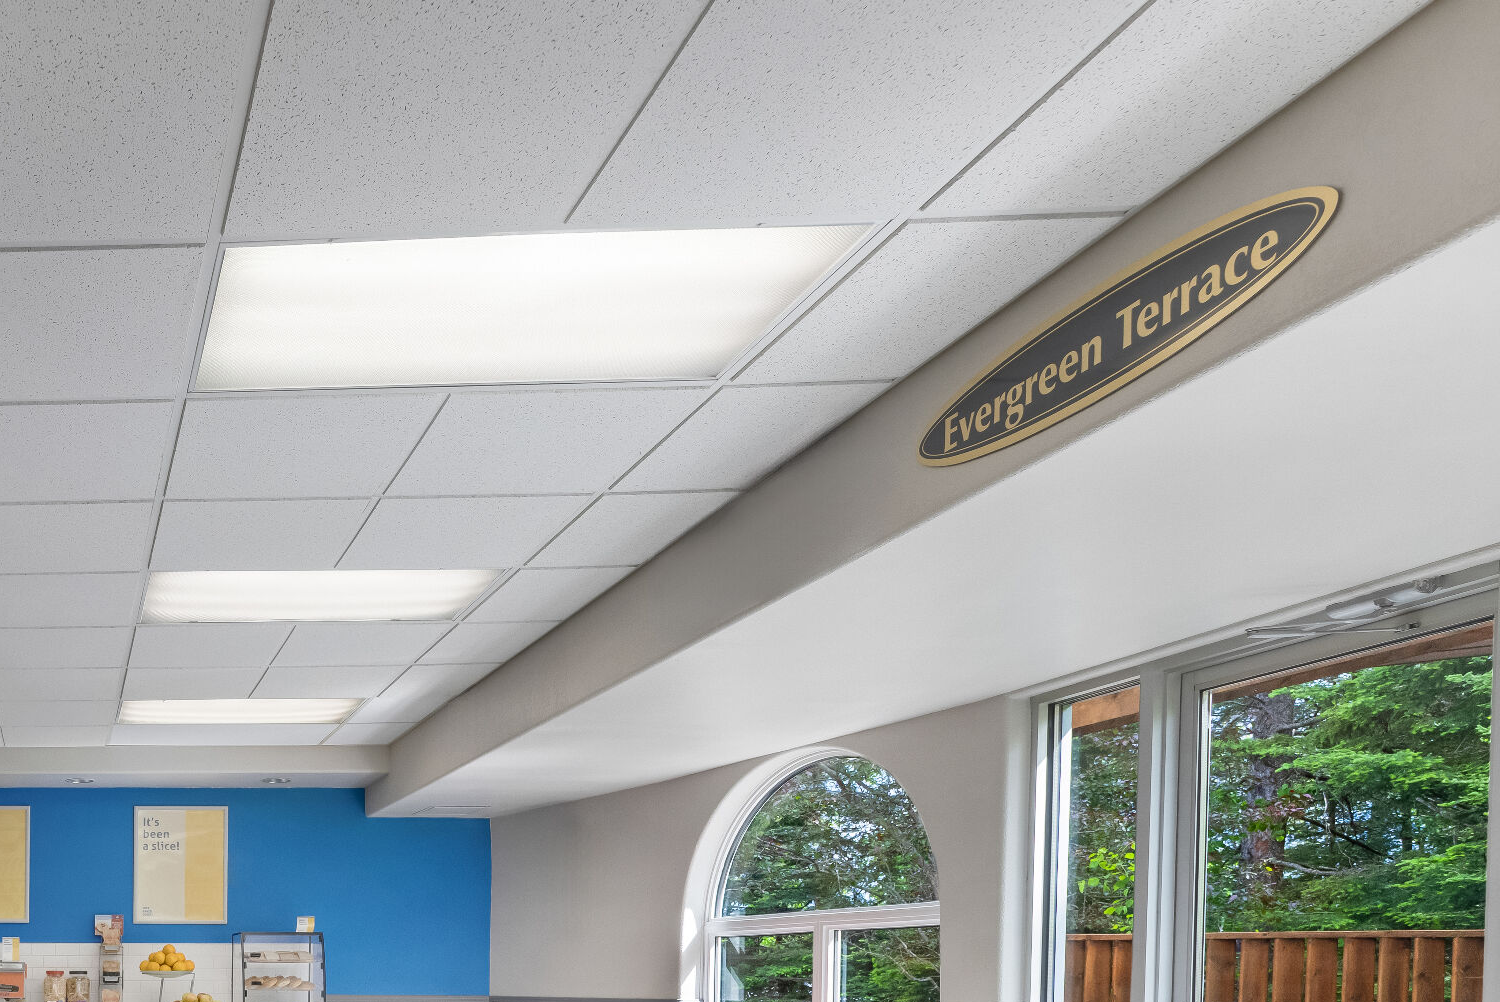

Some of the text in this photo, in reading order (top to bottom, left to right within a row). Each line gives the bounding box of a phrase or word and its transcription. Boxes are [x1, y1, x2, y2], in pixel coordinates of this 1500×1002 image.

[943, 229, 1280, 454] Evergreen Terrace
[143, 817, 160, 827] It's
[143, 830, 170, 839] been
[143, 841, 180, 851] a slice!
